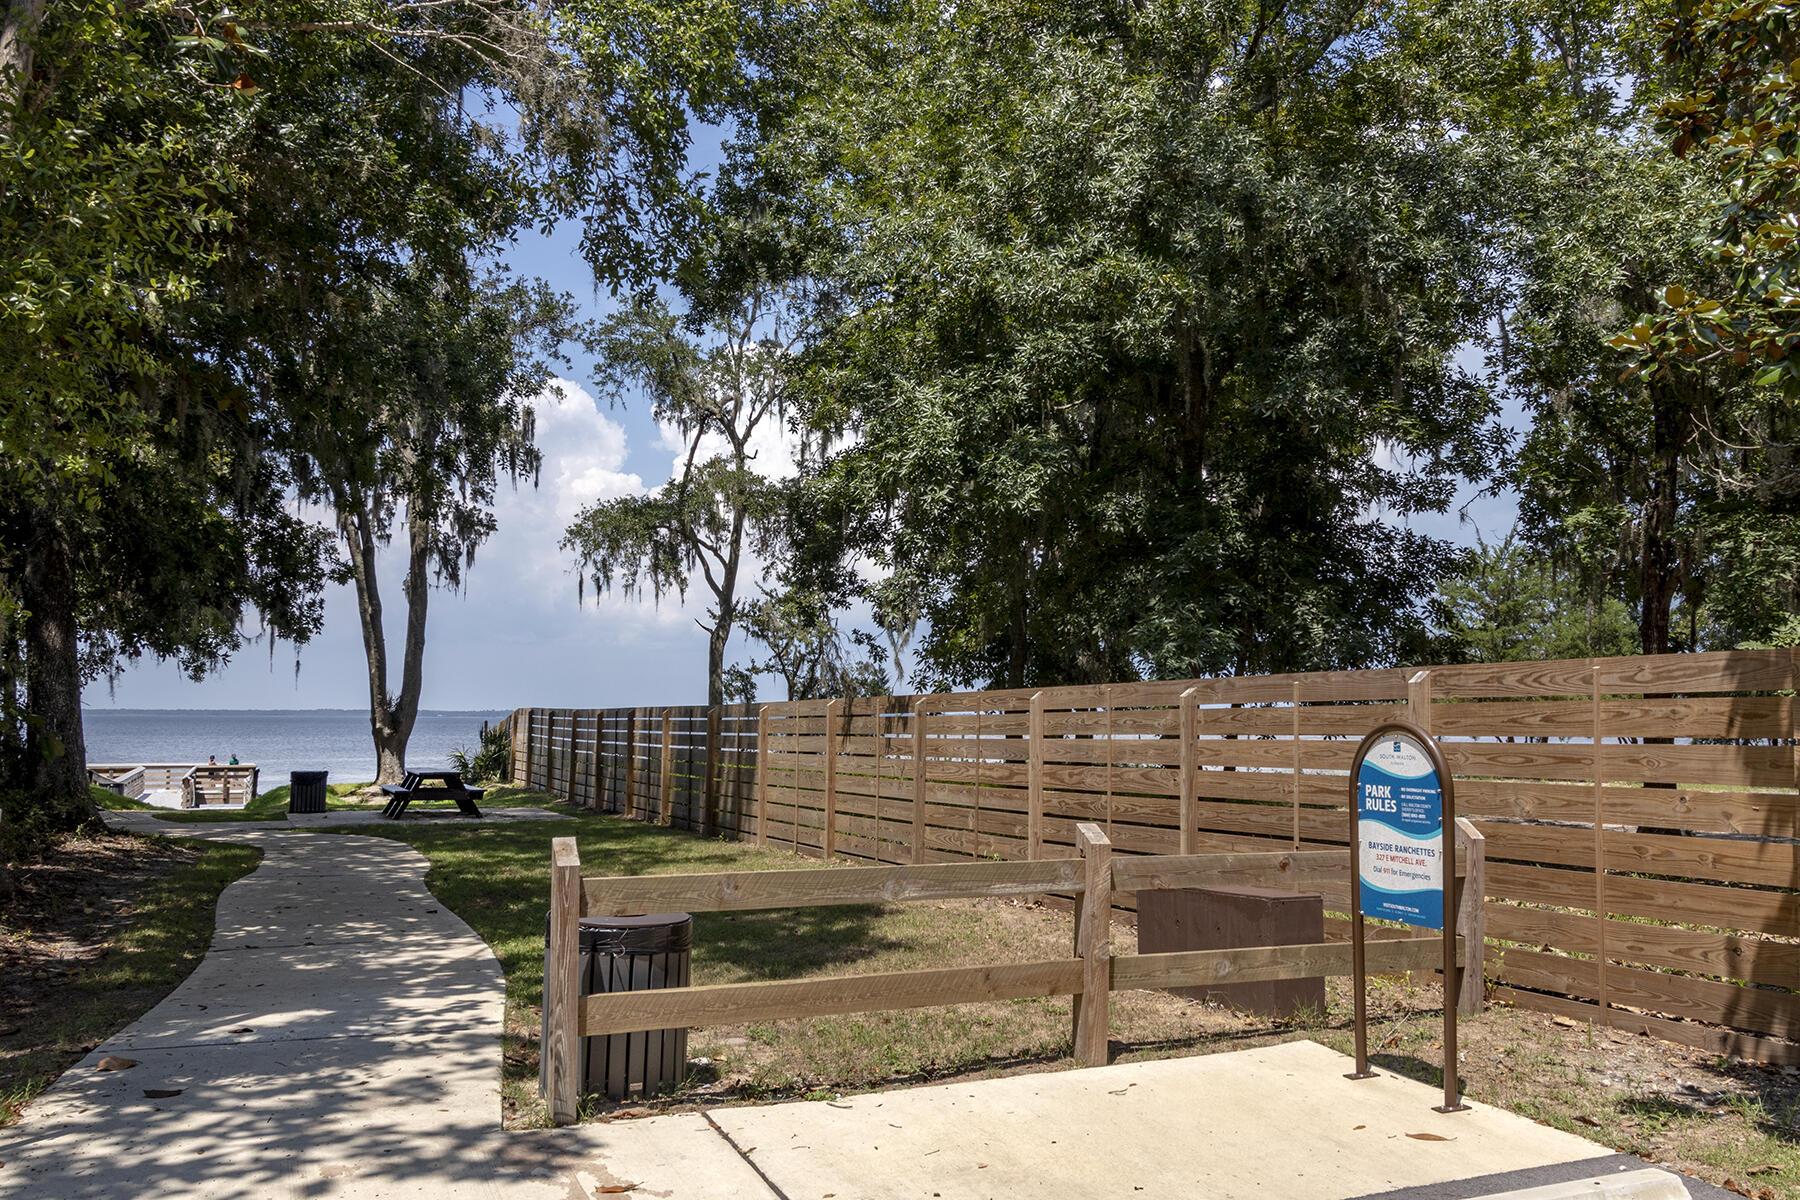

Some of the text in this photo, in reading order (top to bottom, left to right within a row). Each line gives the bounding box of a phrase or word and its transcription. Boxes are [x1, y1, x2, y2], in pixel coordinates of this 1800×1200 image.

[1365, 784, 1397, 812] PARK RULES
[1368, 841, 1436, 857] BAYSIDE RANCHETTES
[1376, 853, 1385, 861] 327
[1390, 855, 1414, 865] MITCHELL
[1415, 859, 1427, 867] AVE.
[1399, 869, 1431, 881] Emergencies
